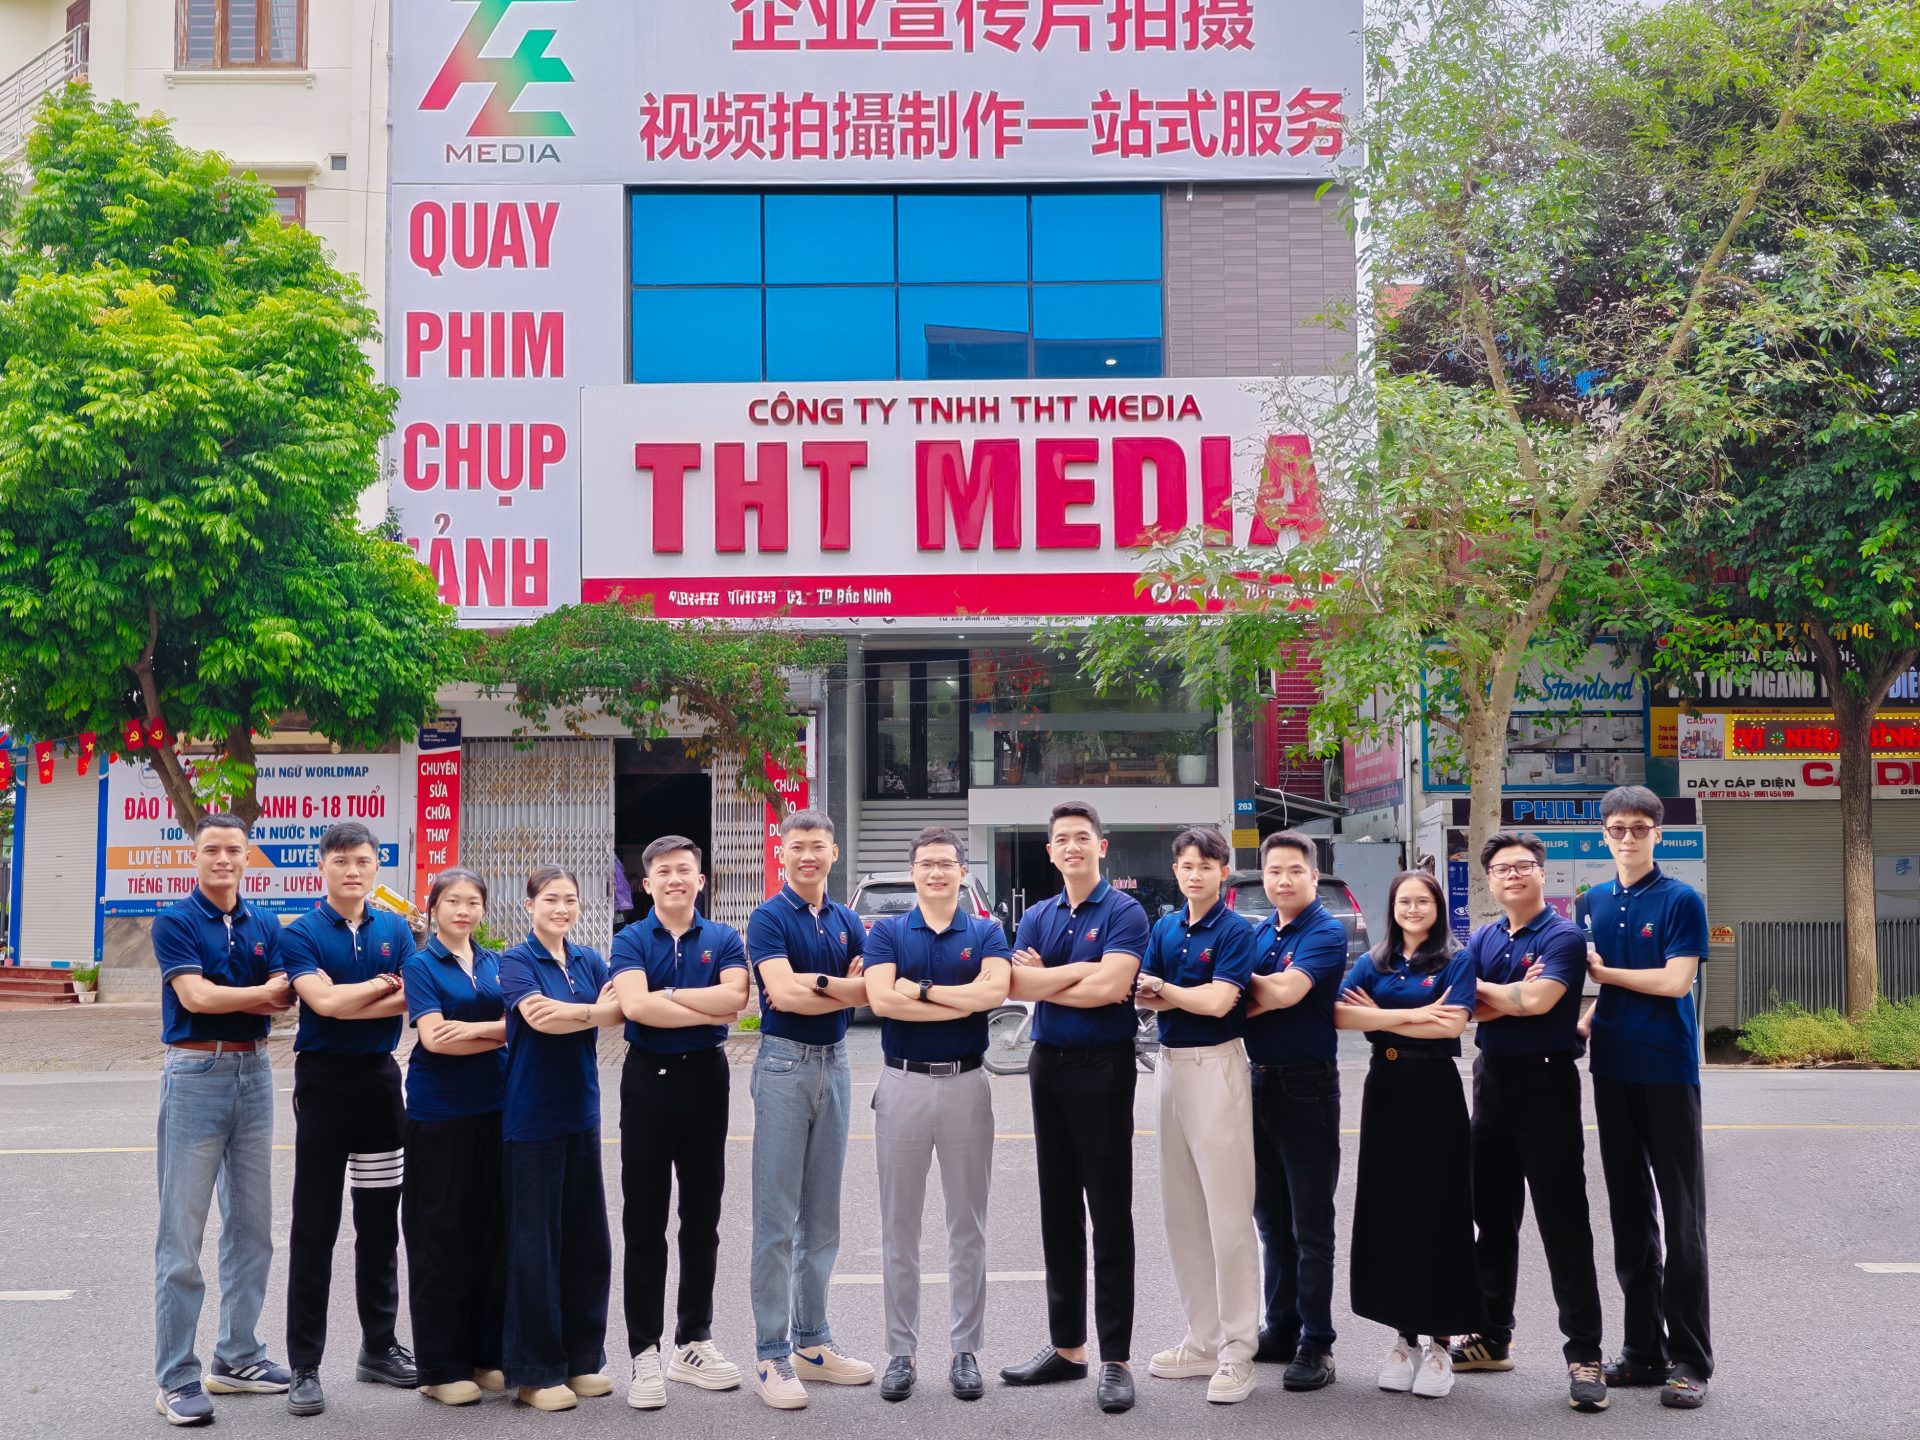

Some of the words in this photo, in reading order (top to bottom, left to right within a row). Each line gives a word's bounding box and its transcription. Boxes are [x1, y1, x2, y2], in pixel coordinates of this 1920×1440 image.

[731, 0, 1255, 52] 企业宣传片拍摄
[446, 143, 561, 163] MEDIA
[409, 201, 560, 276] QUAY
[406, 312, 564, 378] PHIM
[748, 391, 843, 425] CÔNG
[853, 397, 896, 425] TY
[908, 396, 1000, 424] TNHH
[1011, 395, 1078, 423] THT
[1089, 394, 1203, 422] MEDIA
[404, 422, 567, 507] CHỤP
[635, 440, 868, 554] THT
[915, 434, 1330, 552] MEDIA
[427, 512, 548, 606] ẢNH
[1538, 672, 1635, 702] Standard
[1686, 717, 1717, 725] CADIVI
[257, 767, 275, 780] OẠI
[305, 766, 369, 778] WORLDMAP
[420, 761, 458, 776] CHUYÊN
[429, 780, 448, 798] SỬA
[1687, 779, 1719, 788] DÂY
[1724, 776, 1756, 788] CÁP
[1760, 777, 1796, 790] ĐIỆN
[124, 792, 160, 820] ĐÀO
[260, 795, 297, 818] ANH
[302, 795, 341, 819] 6-18
[347, 785, 385, 818] TUỔI
[425, 803, 451, 820] CHỮA
[1513, 800, 1601, 820] PHILI
[160, 827, 190, 840] 100
[269, 823, 305, 840] NƯỚC
[426, 828, 450, 842] THAY
[128, 847, 172, 868] LUYỆN
[176, 849, 194, 865] TH
[429, 846, 447, 864] THẾ
[128, 872, 163, 894] TIẾNG
[167, 876, 199, 894] TRUN
[245, 871, 271, 893] TIẾP
[284, 873, 323, 895] LUYỆN
